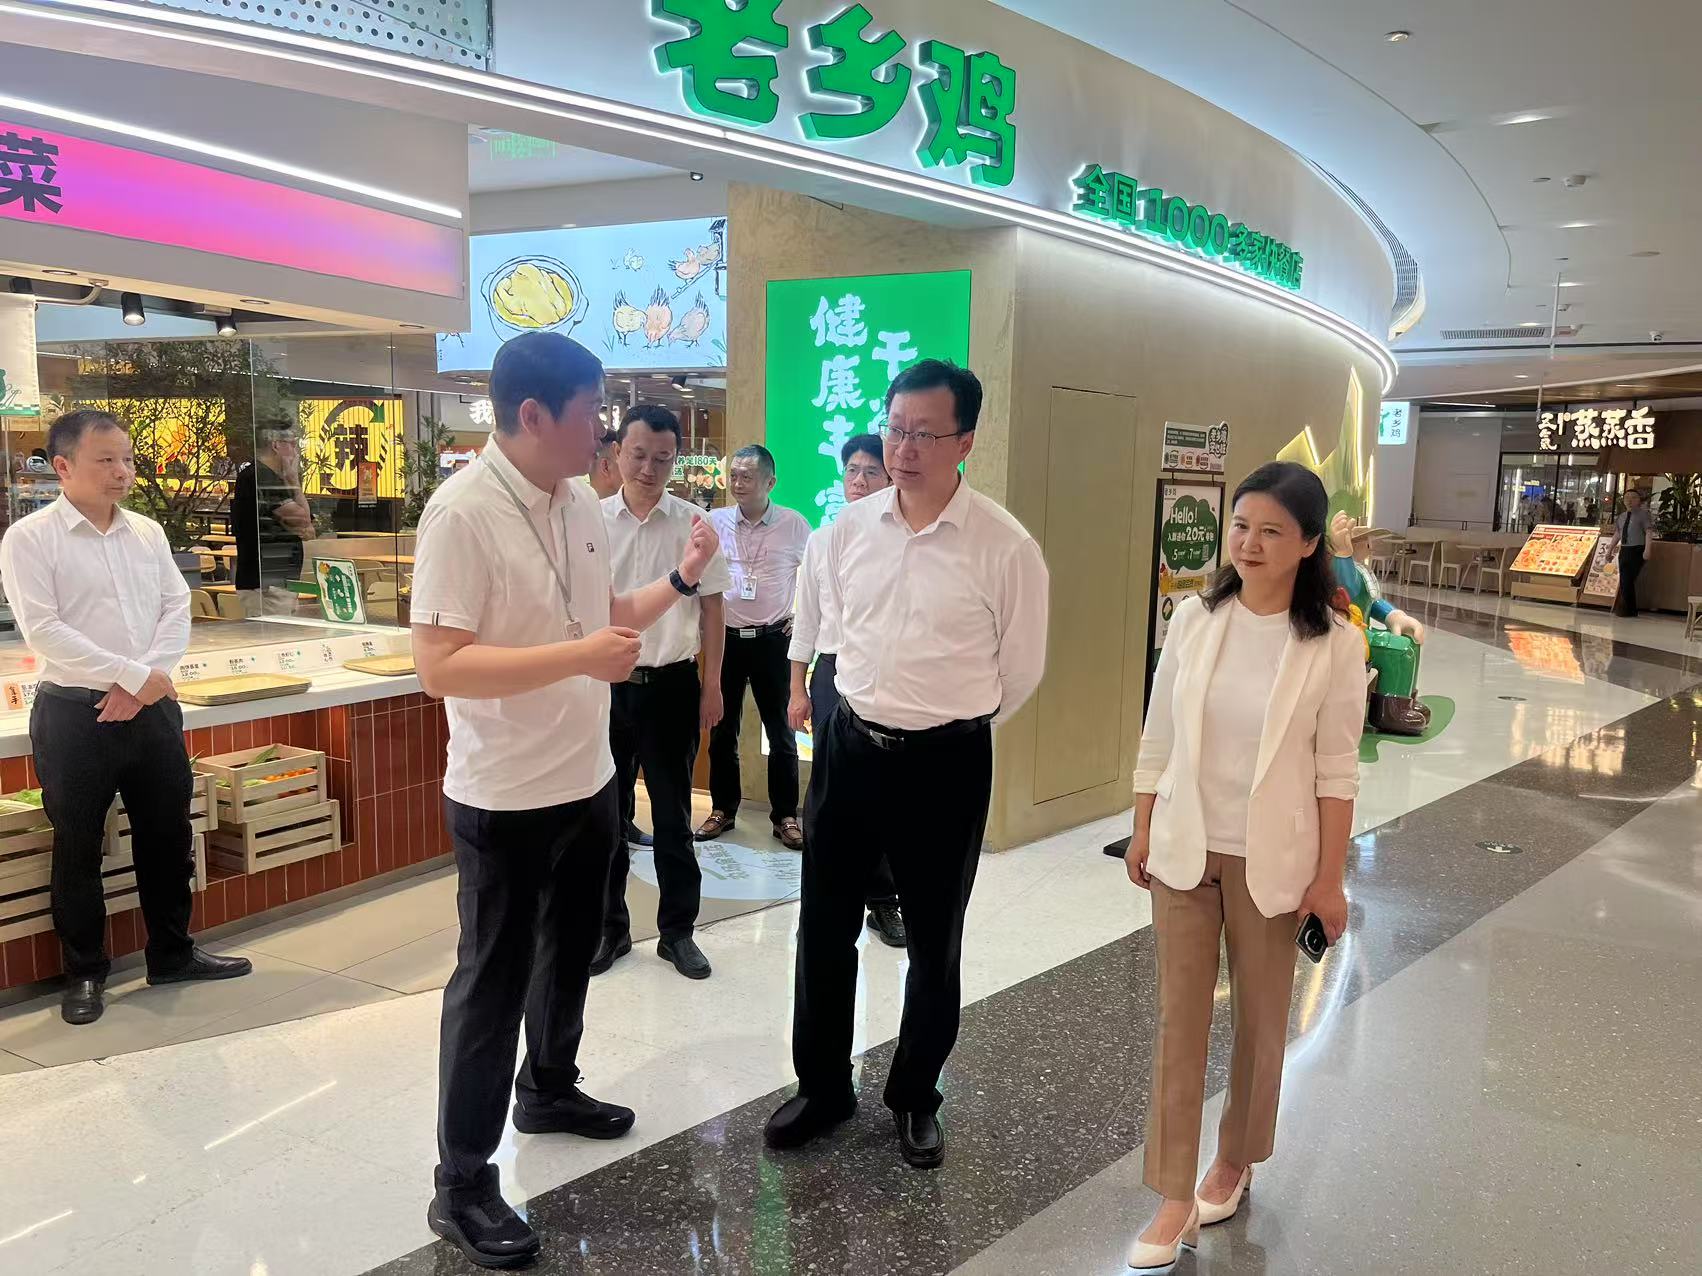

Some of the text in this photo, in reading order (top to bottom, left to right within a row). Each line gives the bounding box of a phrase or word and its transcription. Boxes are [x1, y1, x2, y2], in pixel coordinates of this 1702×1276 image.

[652, 0, 1016, 187] 老乡鸡
[0, 131, 63, 214] 菜
[1170, 506, 1198, 524] Hello!
